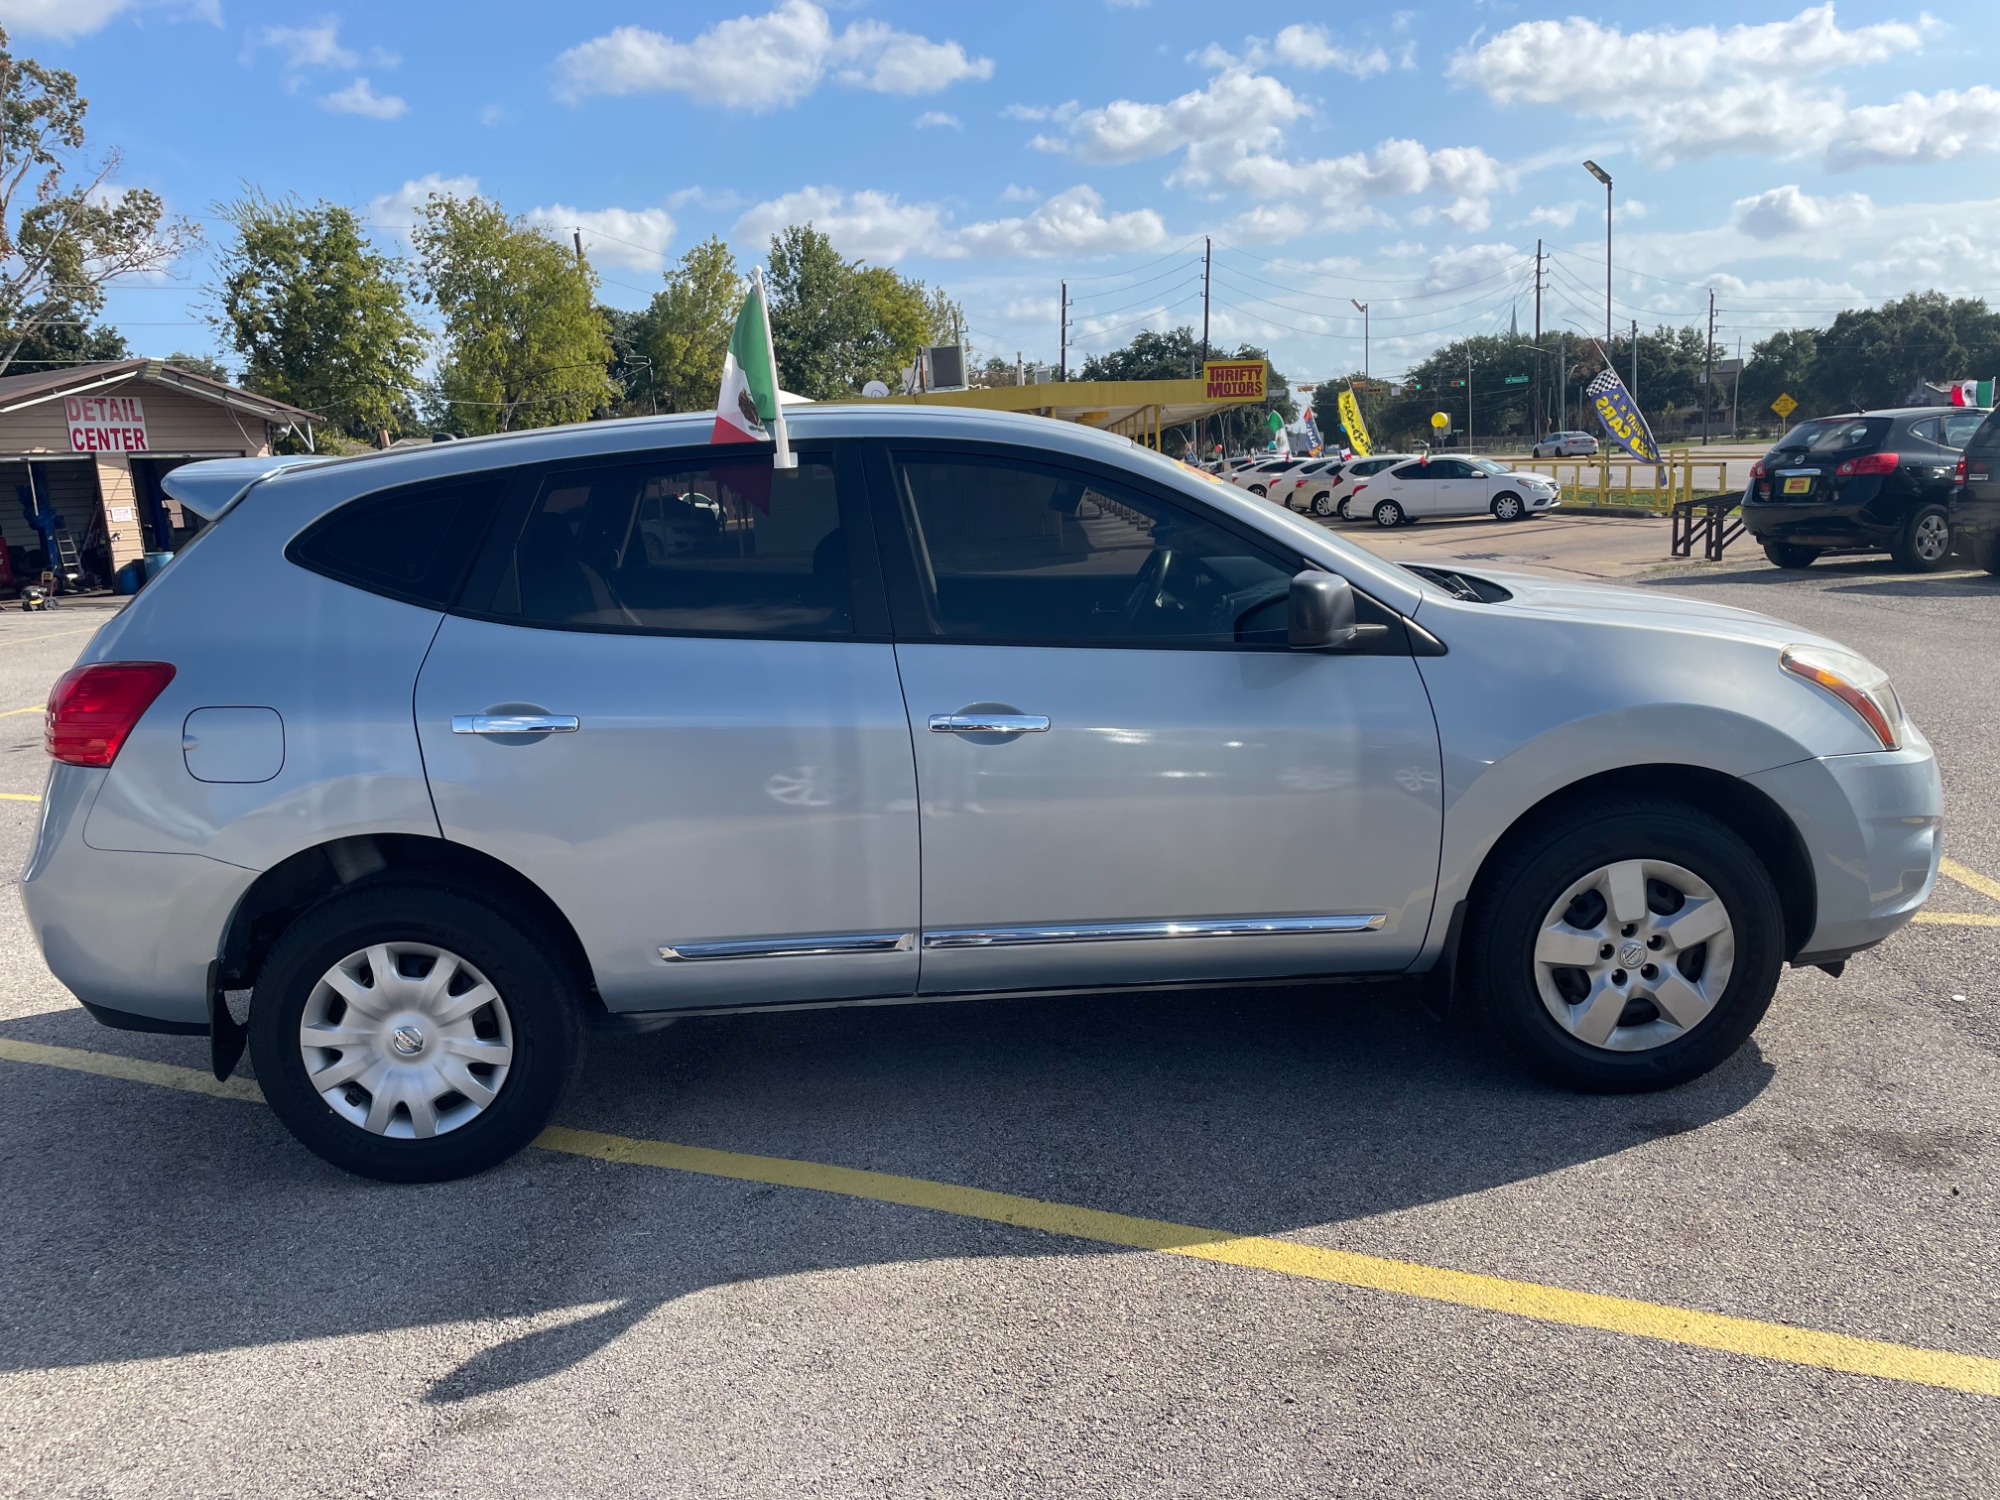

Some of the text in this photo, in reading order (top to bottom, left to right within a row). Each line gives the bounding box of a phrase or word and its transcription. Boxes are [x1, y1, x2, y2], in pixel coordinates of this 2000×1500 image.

[1207, 365, 1263, 382] THRIFTY
[1207, 381, 1263, 398] MOTORS
[65, 397, 143, 422] DETAIL
[72, 427, 147, 451] CENTER
[396, 1030, 420, 1050] NISSA
